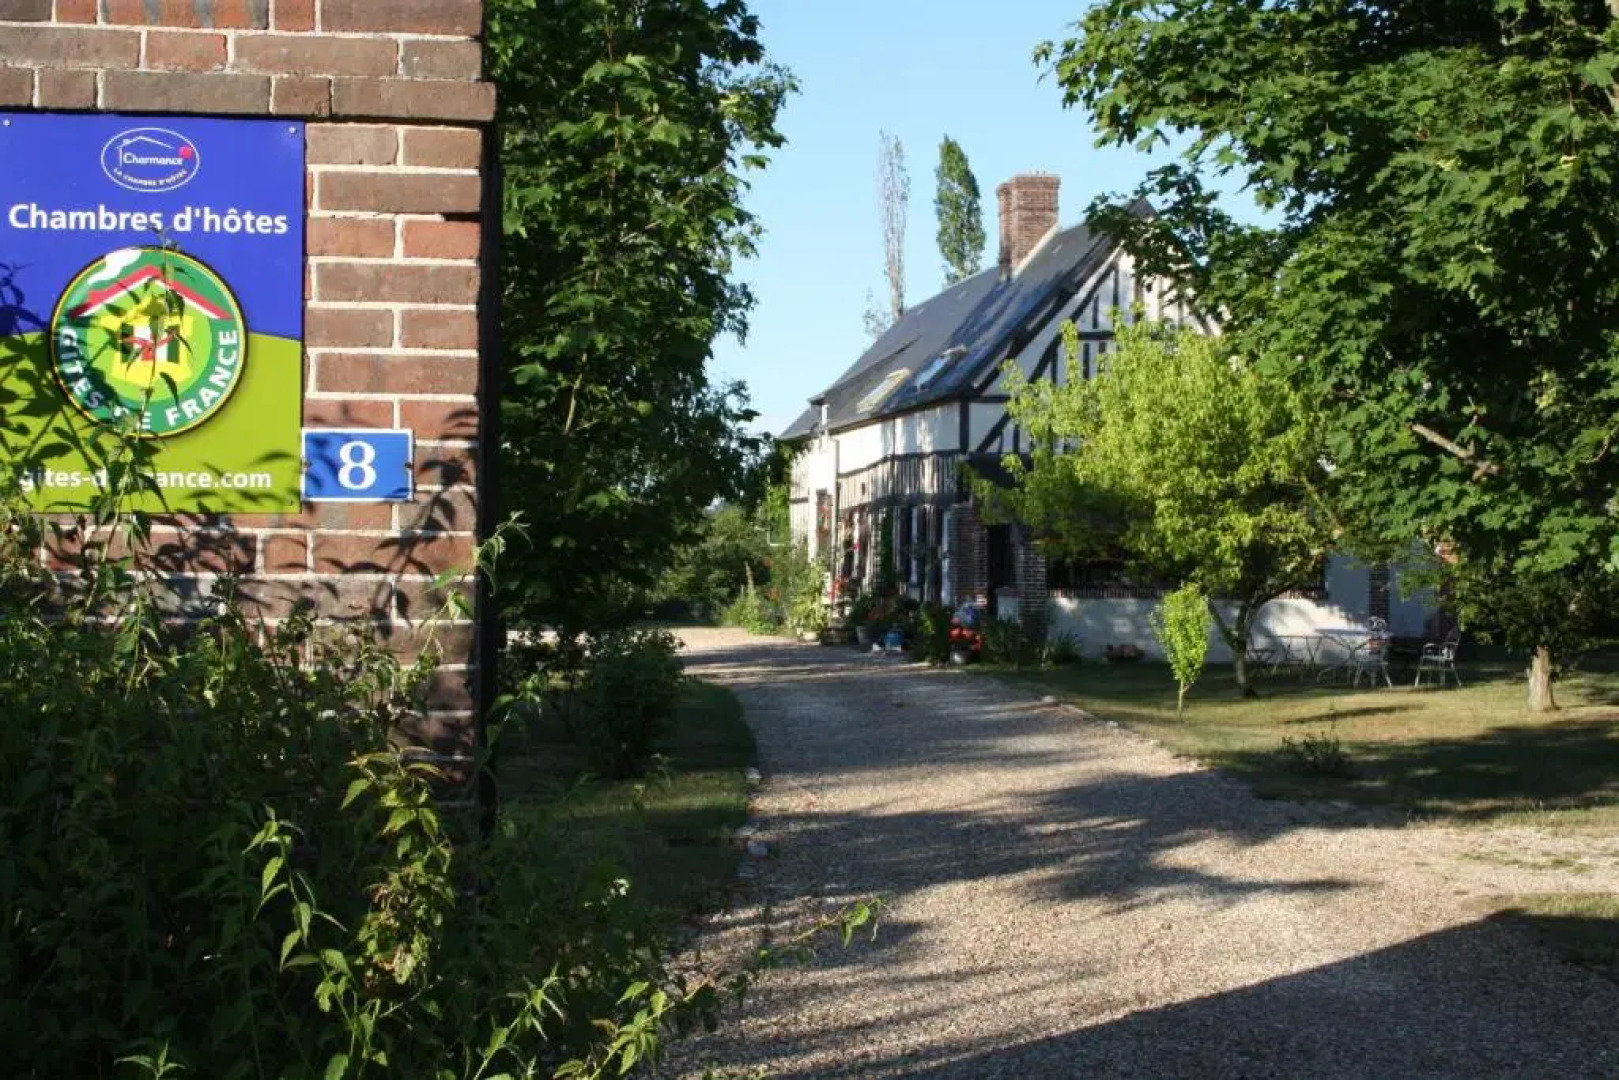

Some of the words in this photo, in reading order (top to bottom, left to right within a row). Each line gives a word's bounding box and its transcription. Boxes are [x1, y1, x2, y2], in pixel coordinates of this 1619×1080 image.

[124, 152, 183, 165] Charmance
[9, 203, 163, 231] Chambres
[173, 206, 288, 234] d'hôtes
[165, 330, 238, 426] FRANCE
[338, 440, 377, 490] 8
